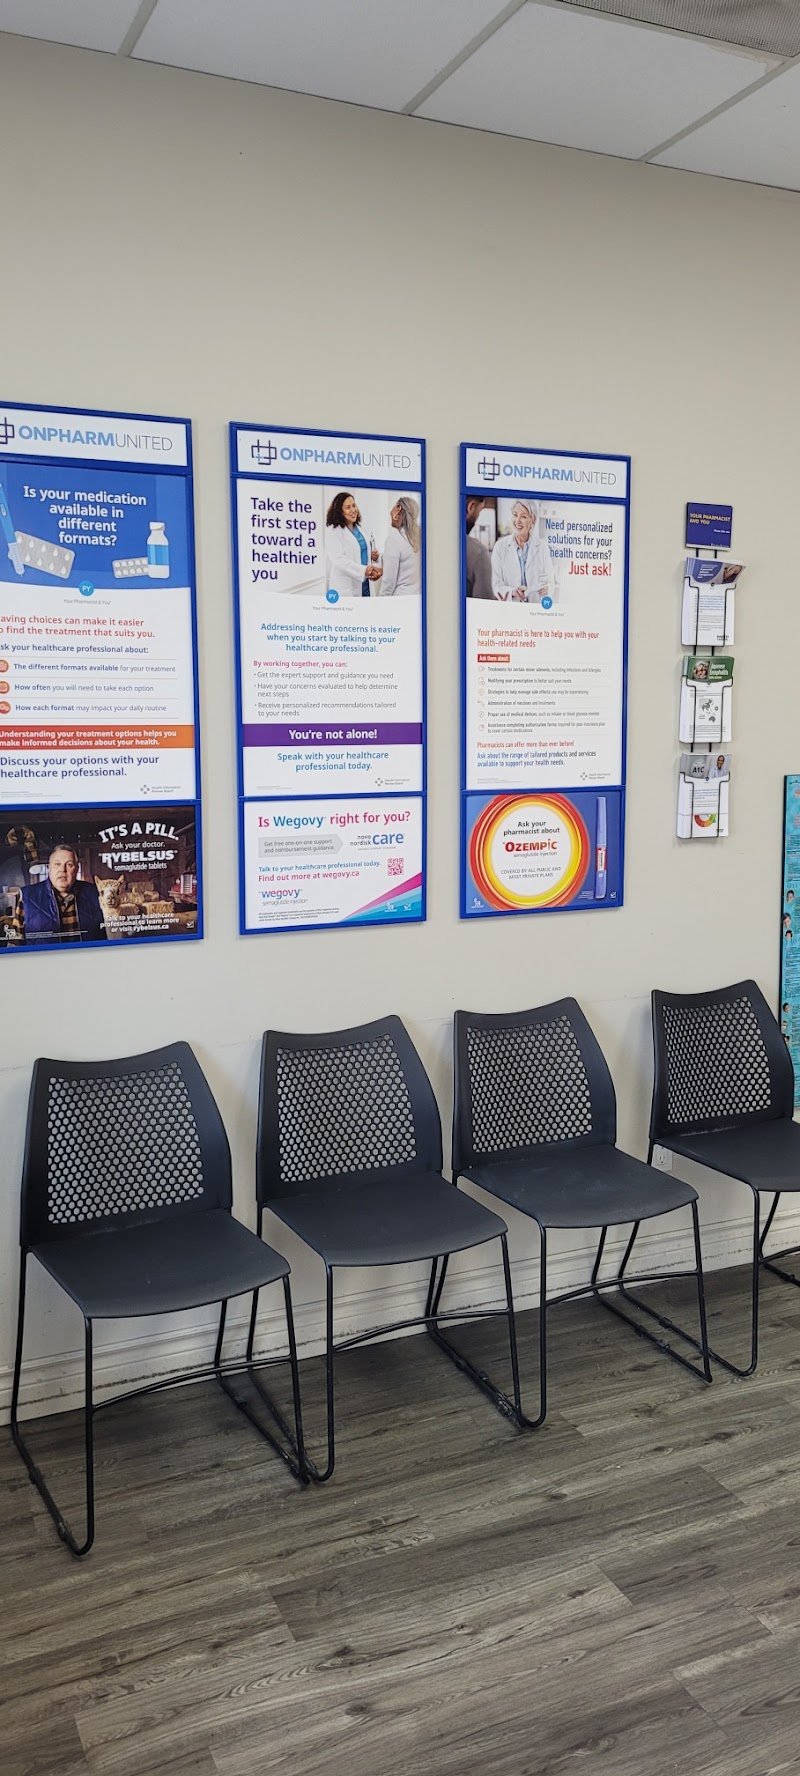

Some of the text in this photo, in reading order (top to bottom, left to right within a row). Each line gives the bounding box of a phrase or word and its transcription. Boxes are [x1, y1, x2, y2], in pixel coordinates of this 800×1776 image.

[18, 425, 172, 451] ONPHARMUNITED
[280, 448, 411, 468] ONPHARMUNITED
[503, 464, 616, 485] ONPHARMUNITED
[24, 486, 146, 506] Is your medication
[50, 503, 123, 518] available in
[251, 498, 312, 513] Take the
[58, 518, 116, 531] different
[251, 514, 316, 533] first step
[546, 519, 612, 533] Need personalized
[59, 532, 117, 546] formats?
[252, 534, 315, 547] toward a
[548, 534, 612, 548] solutions for your
[252, 549, 317, 564] healthier
[550, 547, 612, 560] health concerns?
[569, 562, 612, 576] Just ask!
[252, 570, 278, 582] you
[29, 616, 62, 624] choices
[6, 626, 24, 634] find
[28, 626, 42, 634] the
[46, 628, 91, 636] treatment
[94, 628, 112, 637] that
[113, 629, 135, 637] suits
[261, 624, 306, 633] Addressing
[308, 624, 332, 632] health
[371, 625, 376, 633] is
[328, 634, 338, 643] by
[340, 635, 366, 644] talking
[478, 629, 490, 638] Your
[492, 629, 523, 638] pharmacist
[524, 630, 530, 638] is
[531, 630, 543, 638] here
[544, 630, 550, 638] to
[551, 629, 563, 639] help
[588, 632, 599, 640] your
[286, 644, 378, 653] healthcare professional.
[478, 640, 536, 648] health-related needs
[90, 664, 118, 672] available
[254, 660, 262, 668] By
[263, 660, 290, 669] working
[292, 661, 320, 669] together,
[0, 730, 55, 738] Understanding
[144, 729, 162, 737] helps
[289, 729, 377, 739] You're not alone!
[22, 738, 57, 746] informed
[95, 738, 115, 746] about
[0, 756, 159, 767] Discuss your options with your
[278, 752, 302, 762] Speak
[305, 752, 323, 760] with
[1, 766, 127, 779] healthcare professional.
[295, 762, 372, 772] professional today.
[258, 811, 410, 829] Is Wegovy right for you?
[98, 822, 179, 843] IT'S A PILL.
[504, 827, 539, 836] pharmacist
[372, 834, 404, 845] care
[258, 874, 275, 882] Find
[322, 871, 359, 879] wegovy.ca
[262, 889, 300, 900] wegovy
